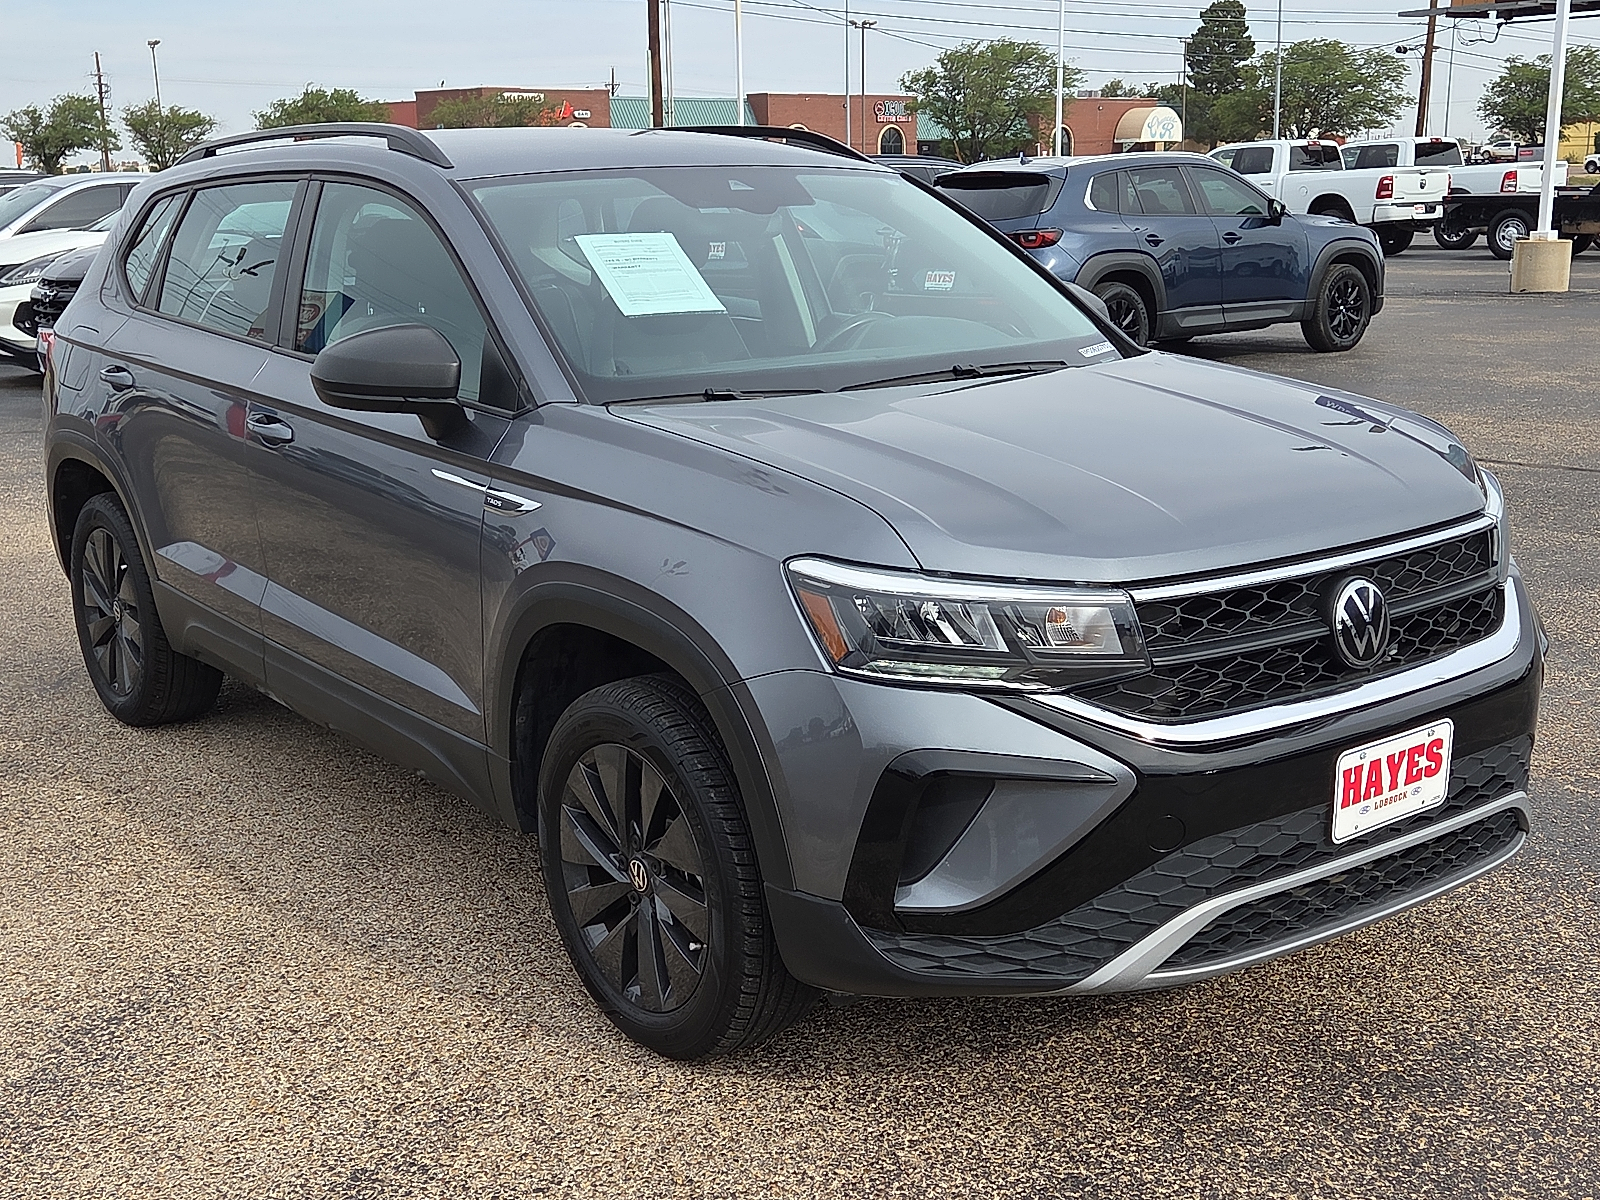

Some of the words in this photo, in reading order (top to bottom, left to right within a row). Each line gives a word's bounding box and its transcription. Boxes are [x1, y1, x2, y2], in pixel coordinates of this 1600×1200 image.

[486, 497, 502, 507] TAOS
[1341, 738, 1444, 810] HAYES
[1374, 791, 1408, 810] LUBBOCK
